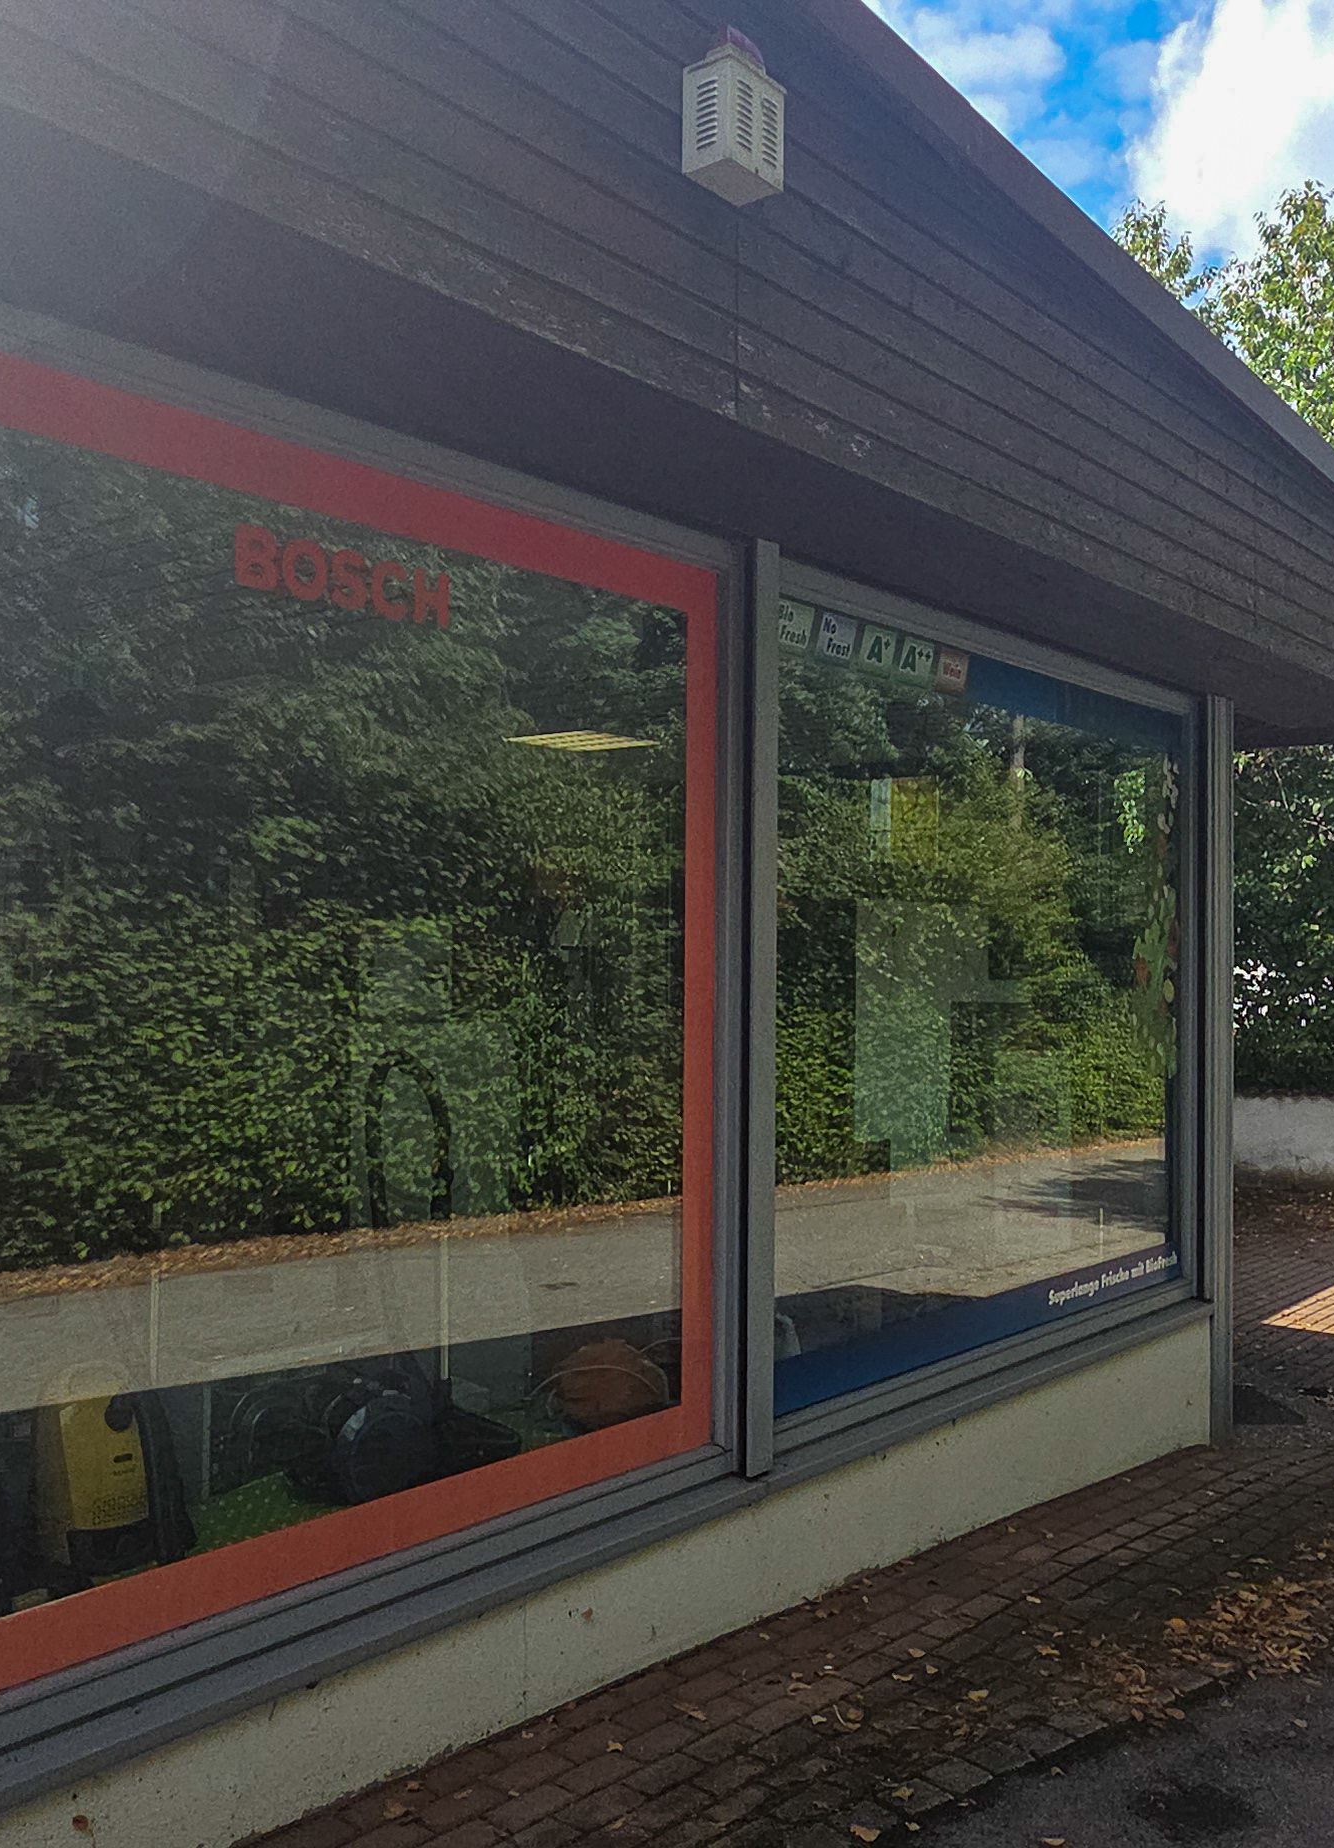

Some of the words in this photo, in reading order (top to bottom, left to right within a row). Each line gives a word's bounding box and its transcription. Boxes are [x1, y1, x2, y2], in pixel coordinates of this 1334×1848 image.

[234, 522, 451, 630] BOSCH
[779, 625, 807, 646] Fresh
[823, 617, 837, 634] No
[826, 637, 851, 657] Frost
[866, 635, 892, 664] A+
[900, 645, 932, 672] A++
[1048, 1280, 1100, 1306] Superlange
[1101, 1267, 1130, 1289] Frische
[1131, 1261, 1145, 1278] mit
